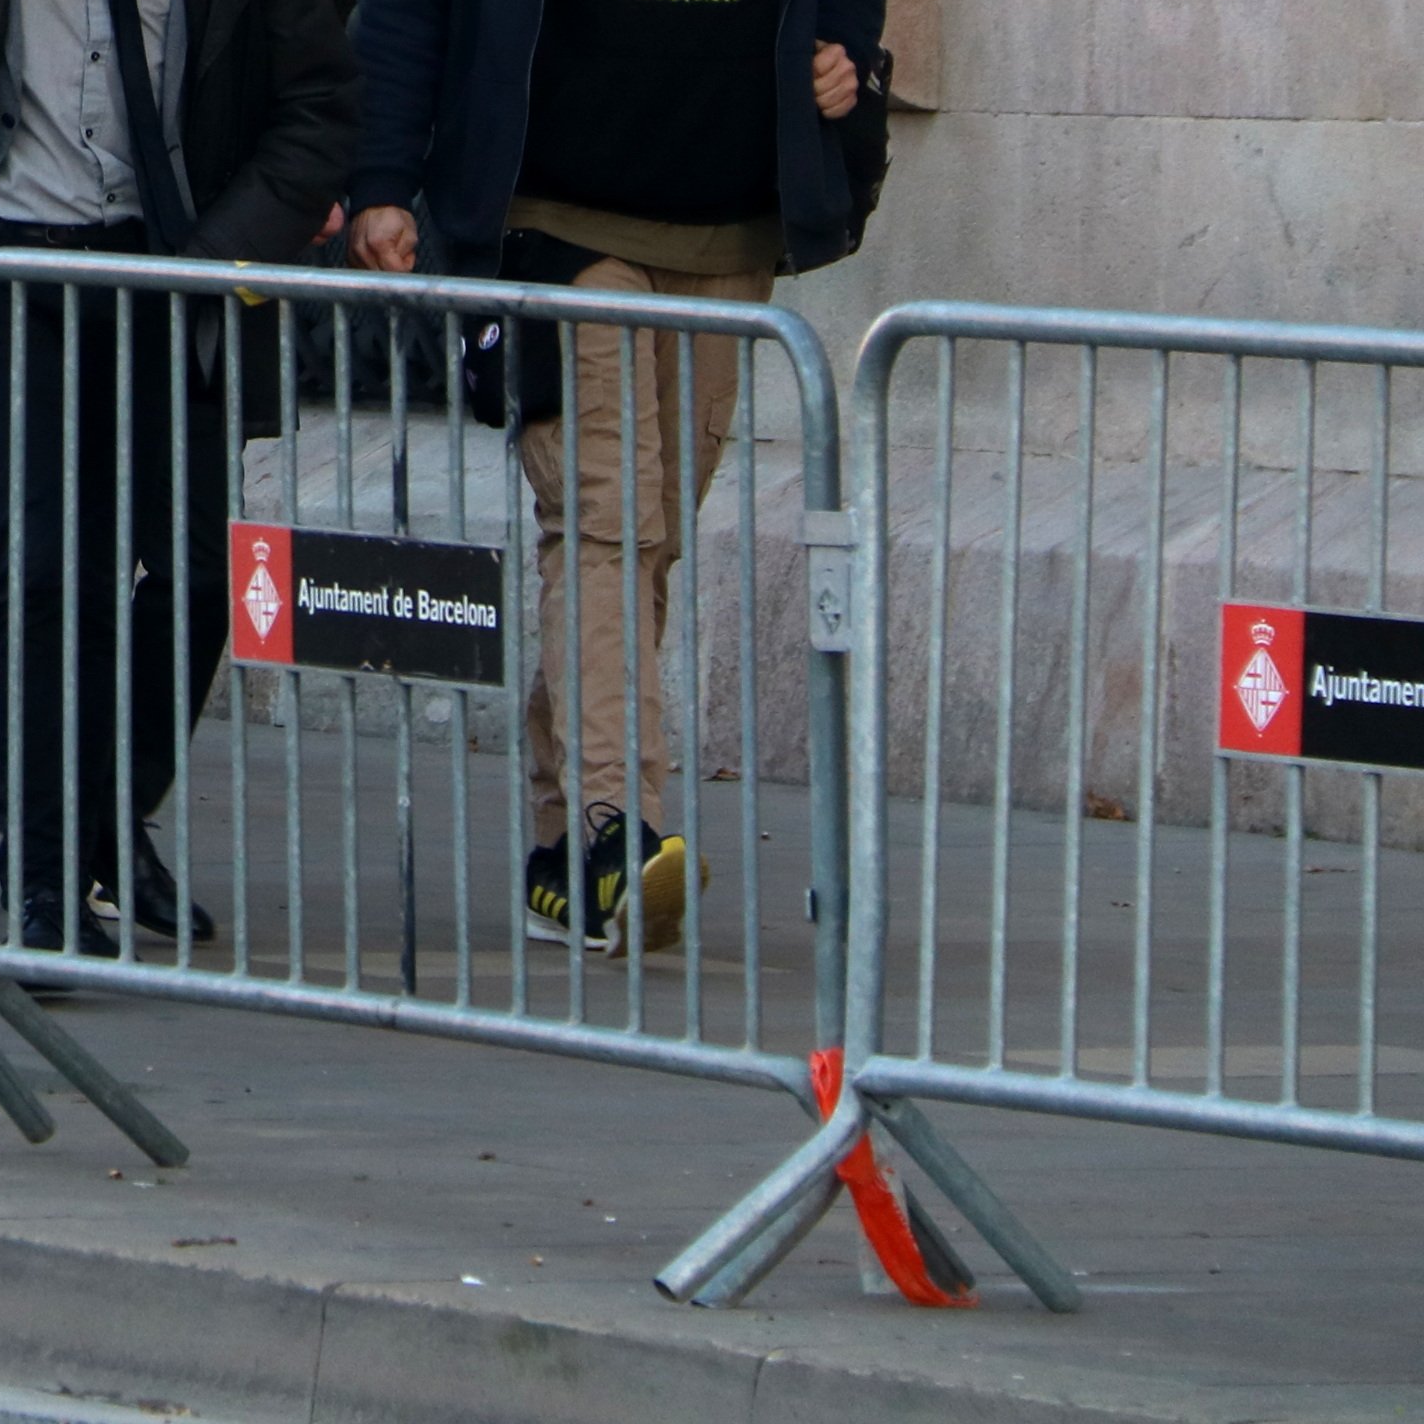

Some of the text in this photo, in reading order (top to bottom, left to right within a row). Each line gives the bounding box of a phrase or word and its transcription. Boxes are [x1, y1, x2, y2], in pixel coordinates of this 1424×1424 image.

[298, 577, 497, 628] Ajuntament de Barcelona
[1311, 664, 1424, 708] Ajuntamen
